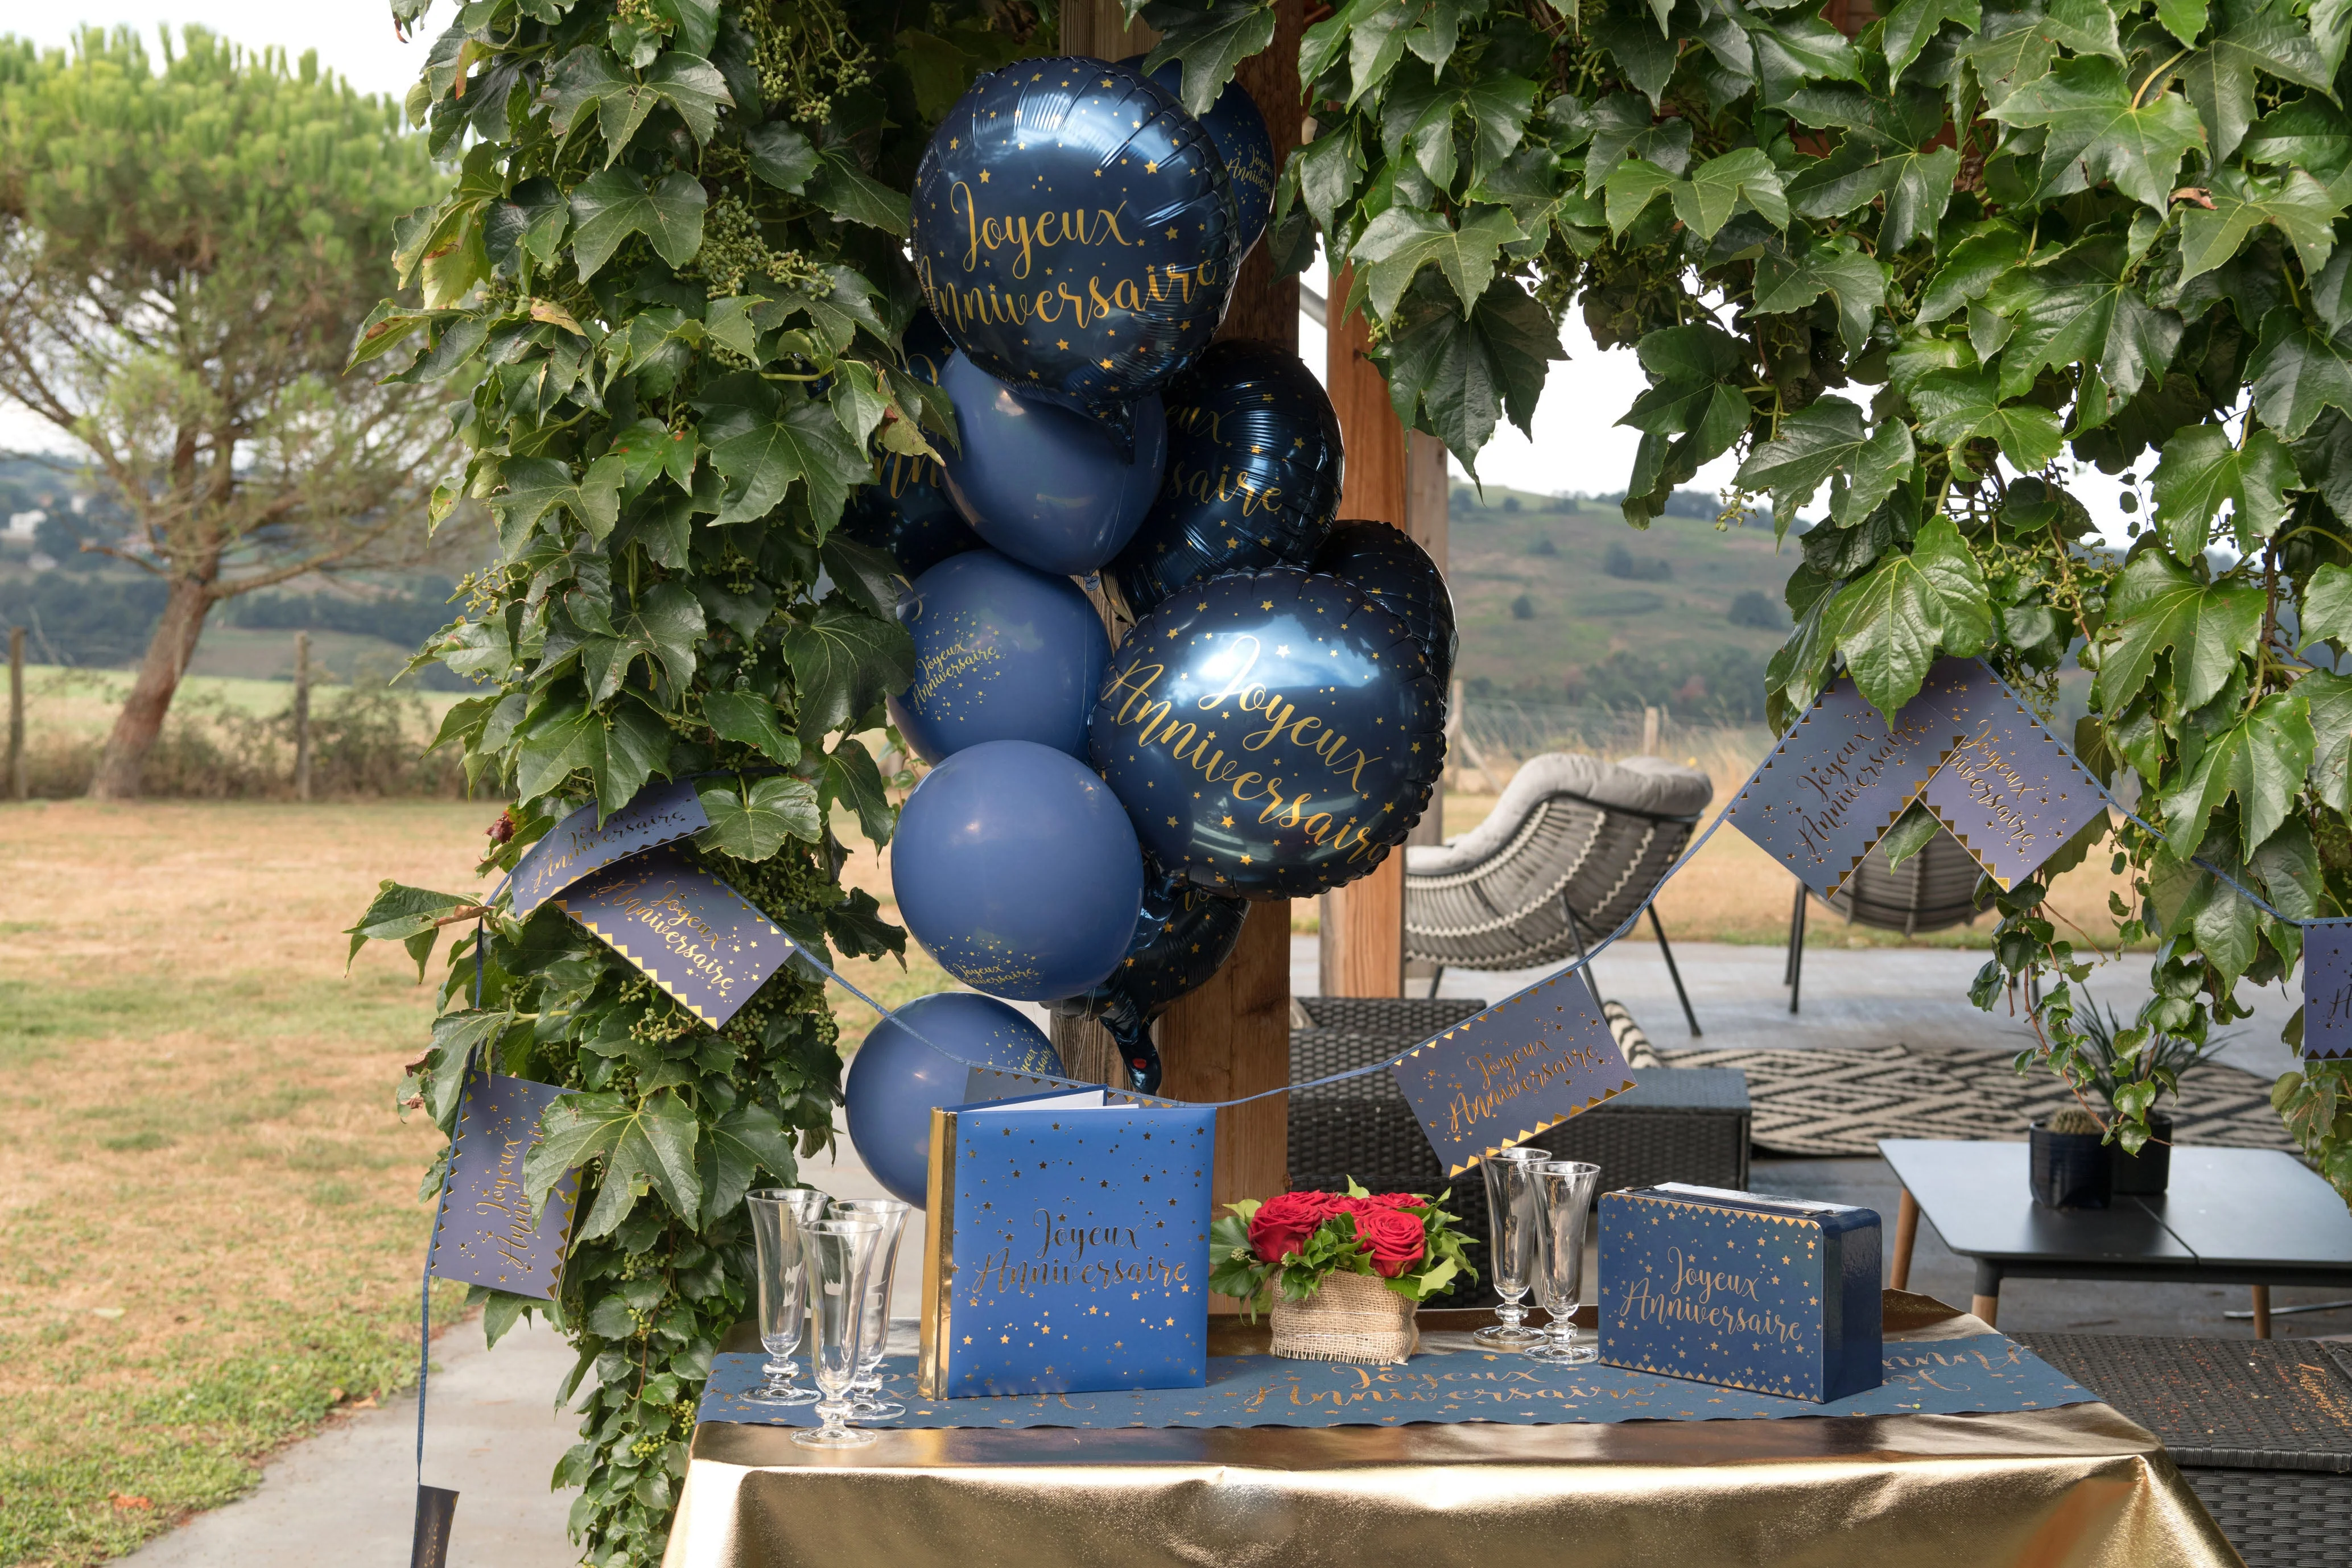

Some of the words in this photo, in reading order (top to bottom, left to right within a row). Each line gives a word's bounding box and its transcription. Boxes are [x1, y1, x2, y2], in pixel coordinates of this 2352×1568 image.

[950, 181, 1132, 279] Joyeux
[912, 646, 996, 711] Anniversaire
[917, 639, 967, 680] Joyeux
[1198, 635, 1383, 793] Joyeux
[1796, 726, 1875, 803] Joyeux
[1960, 719, 2035, 803] Joyeux
[534, 811, 683, 889] Anniversaire
[597, 880, 735, 990] Anniversaire
[650, 881, 726, 951] Joyeux
[952, 963, 1005, 979] Joyeux
[1447, 1044, 1598, 1133] Anniversaire
[1466, 1038, 1555, 1090] Joyeux
[475, 1134, 523, 1218] Joyeux
[1033, 1208, 1141, 1262] Joyeux
[972, 1247, 1187, 1294] Anniversaire
[1667, 1246, 1760, 1304] Joyeux
[1620, 1277, 1802, 1343] Anniversaire
[1243, 1384, 1655, 1406] Anniversaire
[1331, 1365, 1546, 1390] Joyeux
